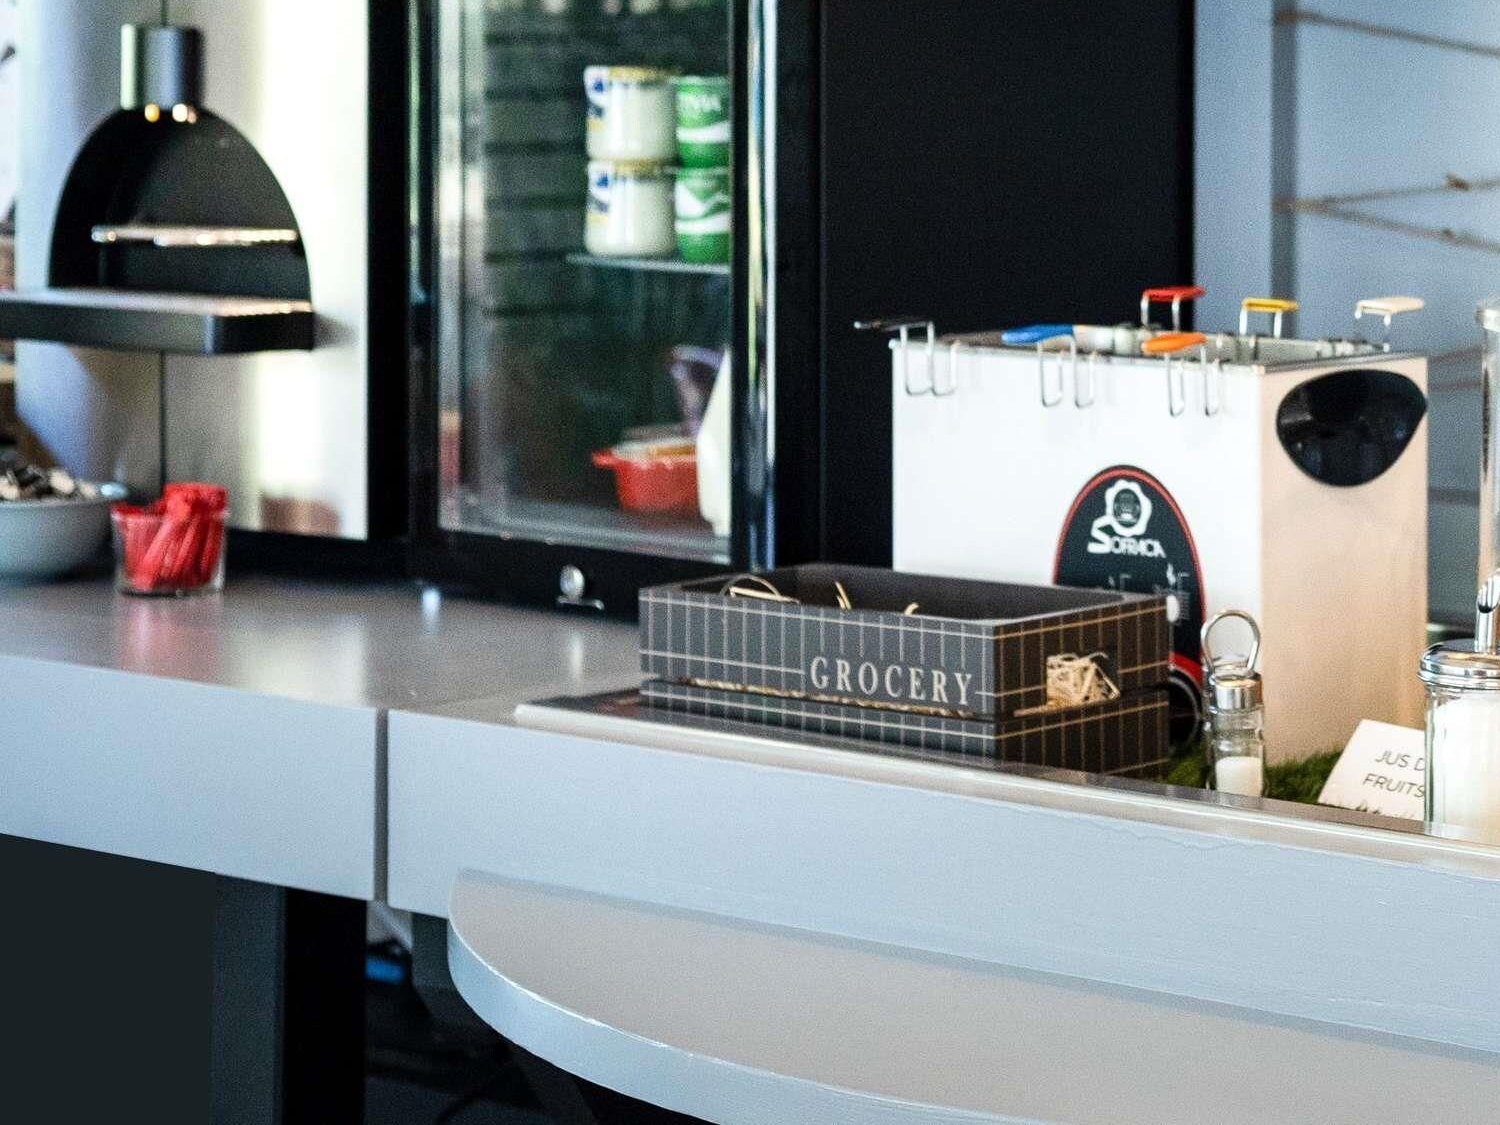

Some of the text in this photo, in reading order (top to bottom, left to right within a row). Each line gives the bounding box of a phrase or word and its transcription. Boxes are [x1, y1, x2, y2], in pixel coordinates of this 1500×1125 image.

[809, 656, 973, 707] GROCERY
[1374, 750, 1426, 772] JUS D
[1362, 773, 1426, 798] FRUITS
